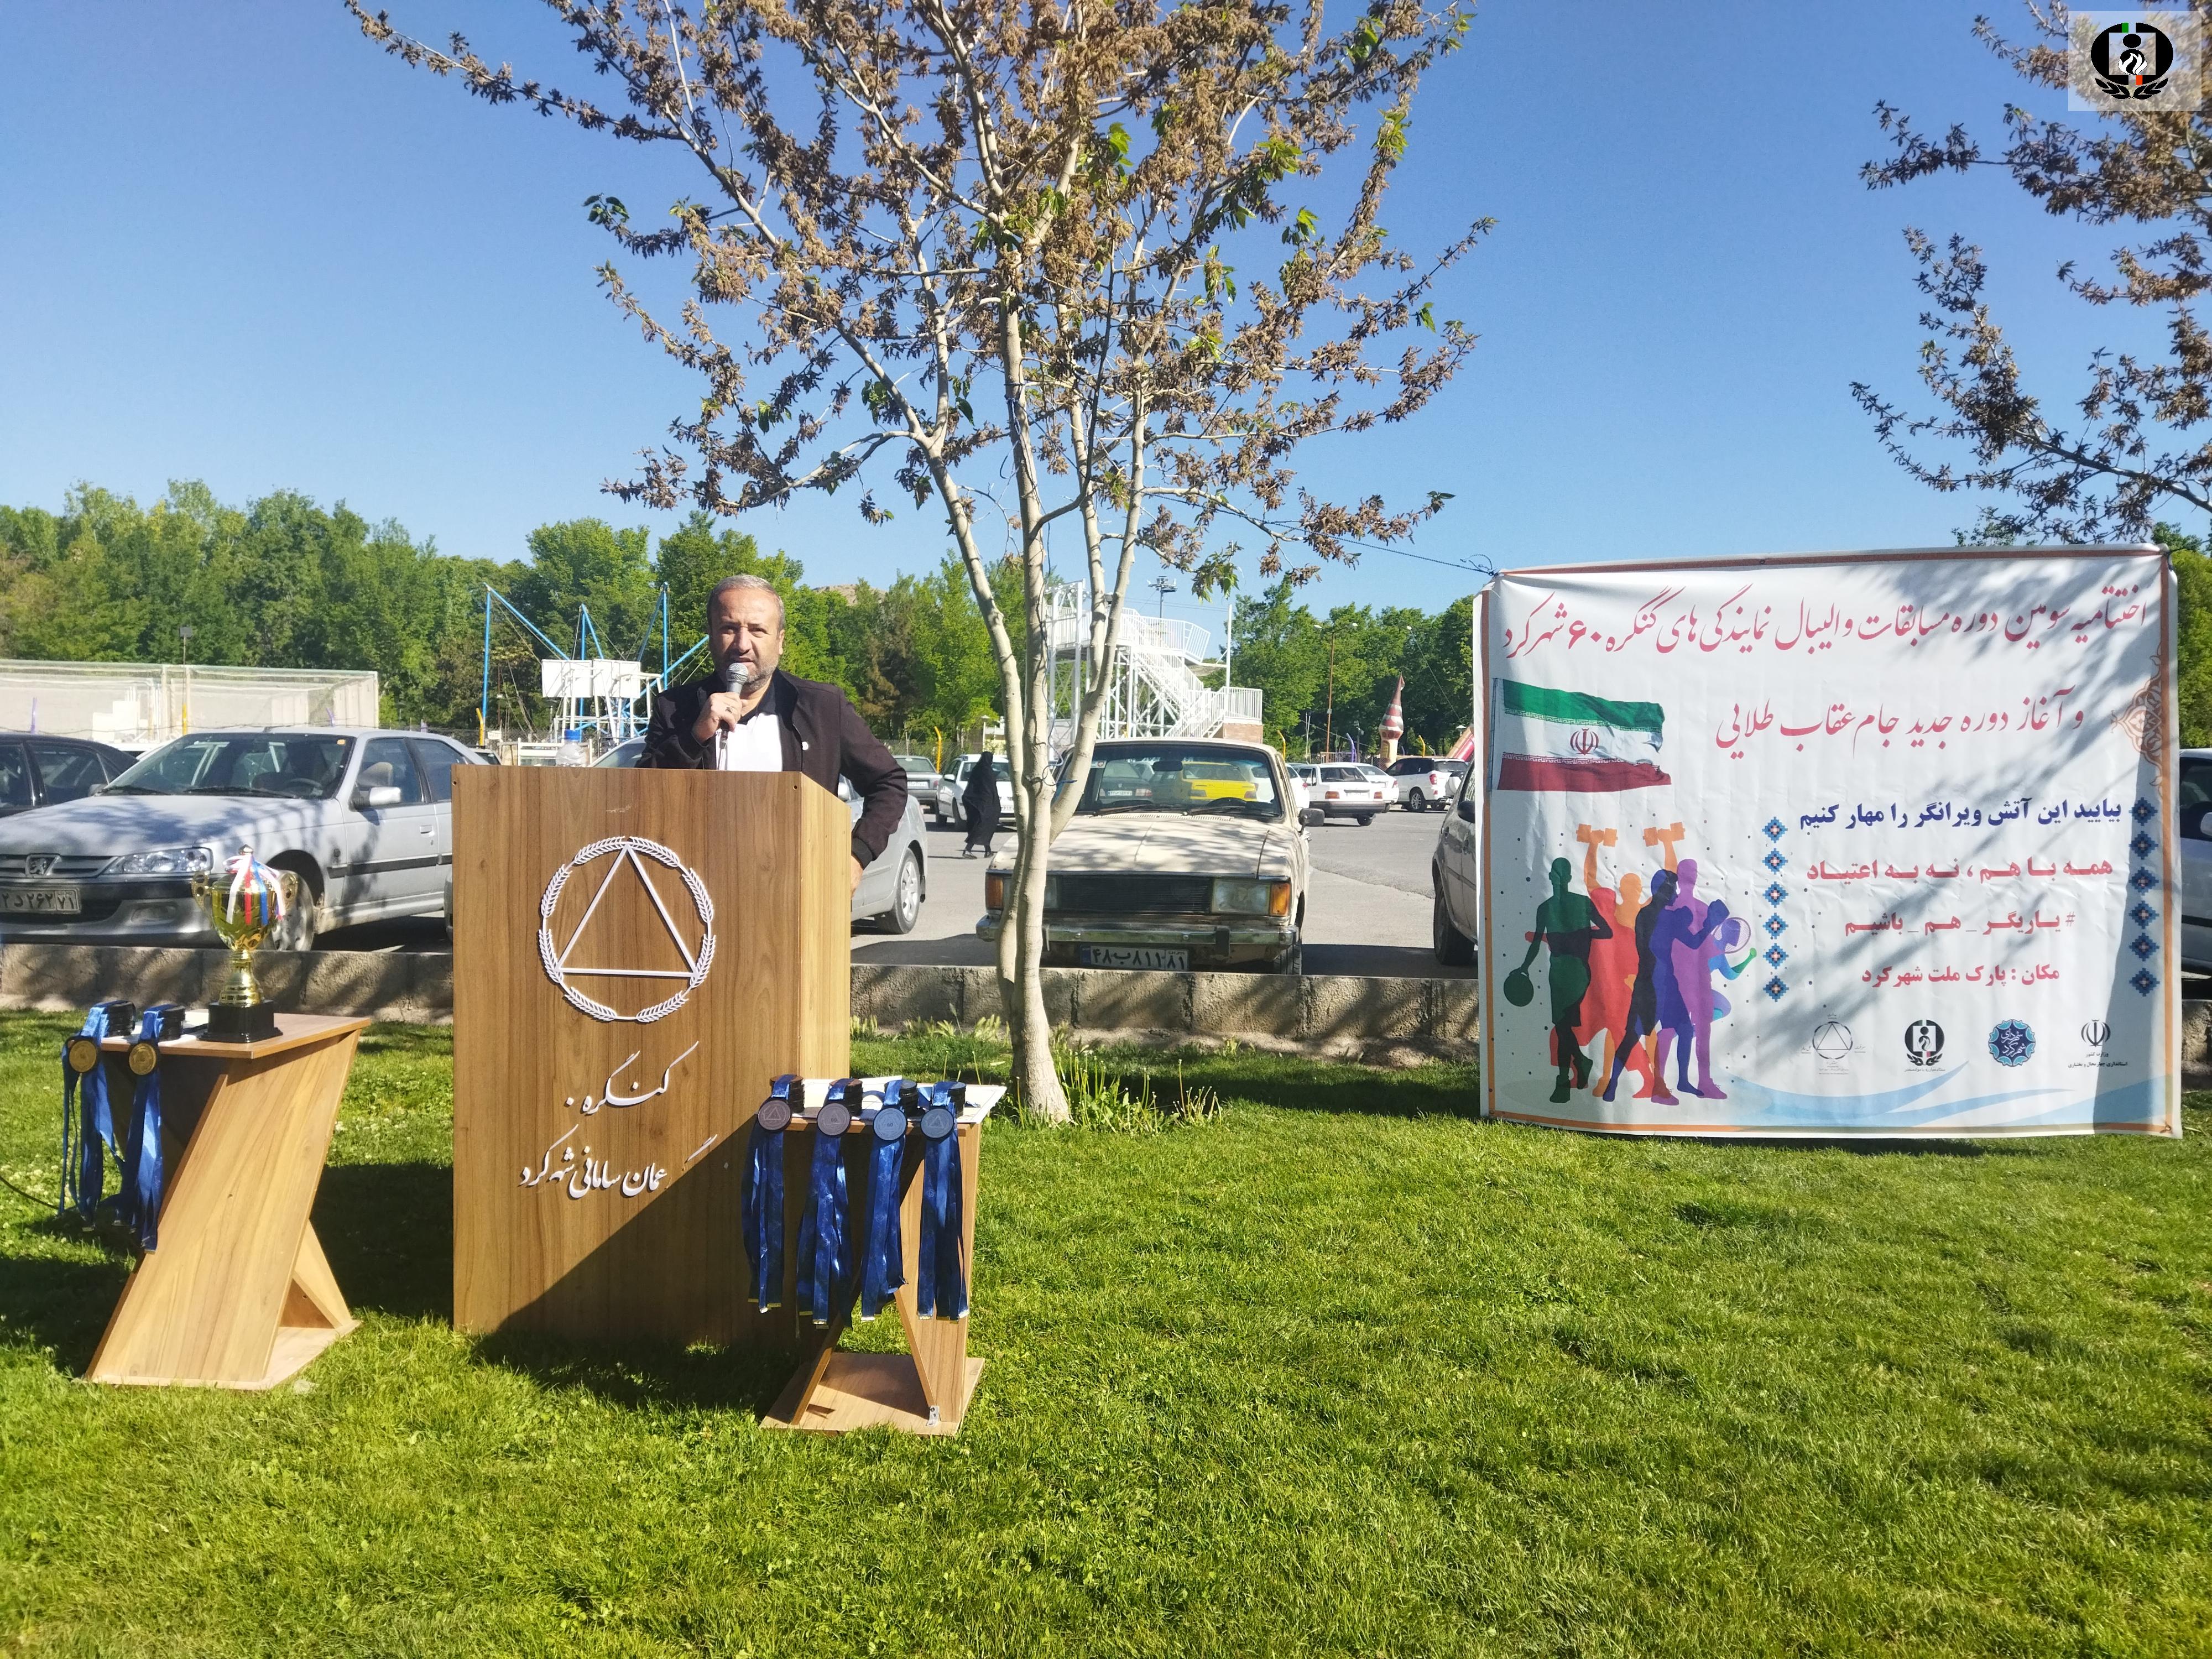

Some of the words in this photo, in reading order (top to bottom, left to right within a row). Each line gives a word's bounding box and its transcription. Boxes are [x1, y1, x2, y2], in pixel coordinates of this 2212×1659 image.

[1605, 585, 1687, 653] کنگره
[1858, 604, 1950, 647] مسابقات
[1951, 612, 1998, 633] دوره
[2004, 603, 2071, 650] سومین
[2070, 584, 2147, 644] اختتامیه
[1568, 619, 1603, 650] ۶۰
[2016, 684, 2077, 731] آغاز
[2071, 709, 2085, 730] و
[1715, 697, 1775, 760] طلایی
[1780, 703, 1856, 752] عقاب
[1853, 703, 1900, 759] جام
[1906, 715, 1954, 750] جدید
[1960, 711, 2009, 732] دوره
[1800, 804, 1839, 830] کنیم
[1845, 802, 1885, 829] مهار
[1892, 802, 1908, 828] را
[1914, 801, 1983, 828] ویرانگر
[1988, 797, 2033, 826] آتش
[2038, 801, 2068, 825] این
[2074, 799, 2122, 825] بیایید
[1806, 859, 1878, 885] اعتیاد
[1884, 863, 1919, 883] به
[1925, 858, 1960, 879] نه
[2027, 855, 2056, 881] با
[2063, 859, 2113, 877] همه
[1928, 966, 1961, 983] ملت
[1965, 964, 2006, 987] پارک
[582, 1040, 700, 1115] کنگره
[568, 1145, 622, 1199] سامانی
[622, 1162, 667, 1197] عمان
